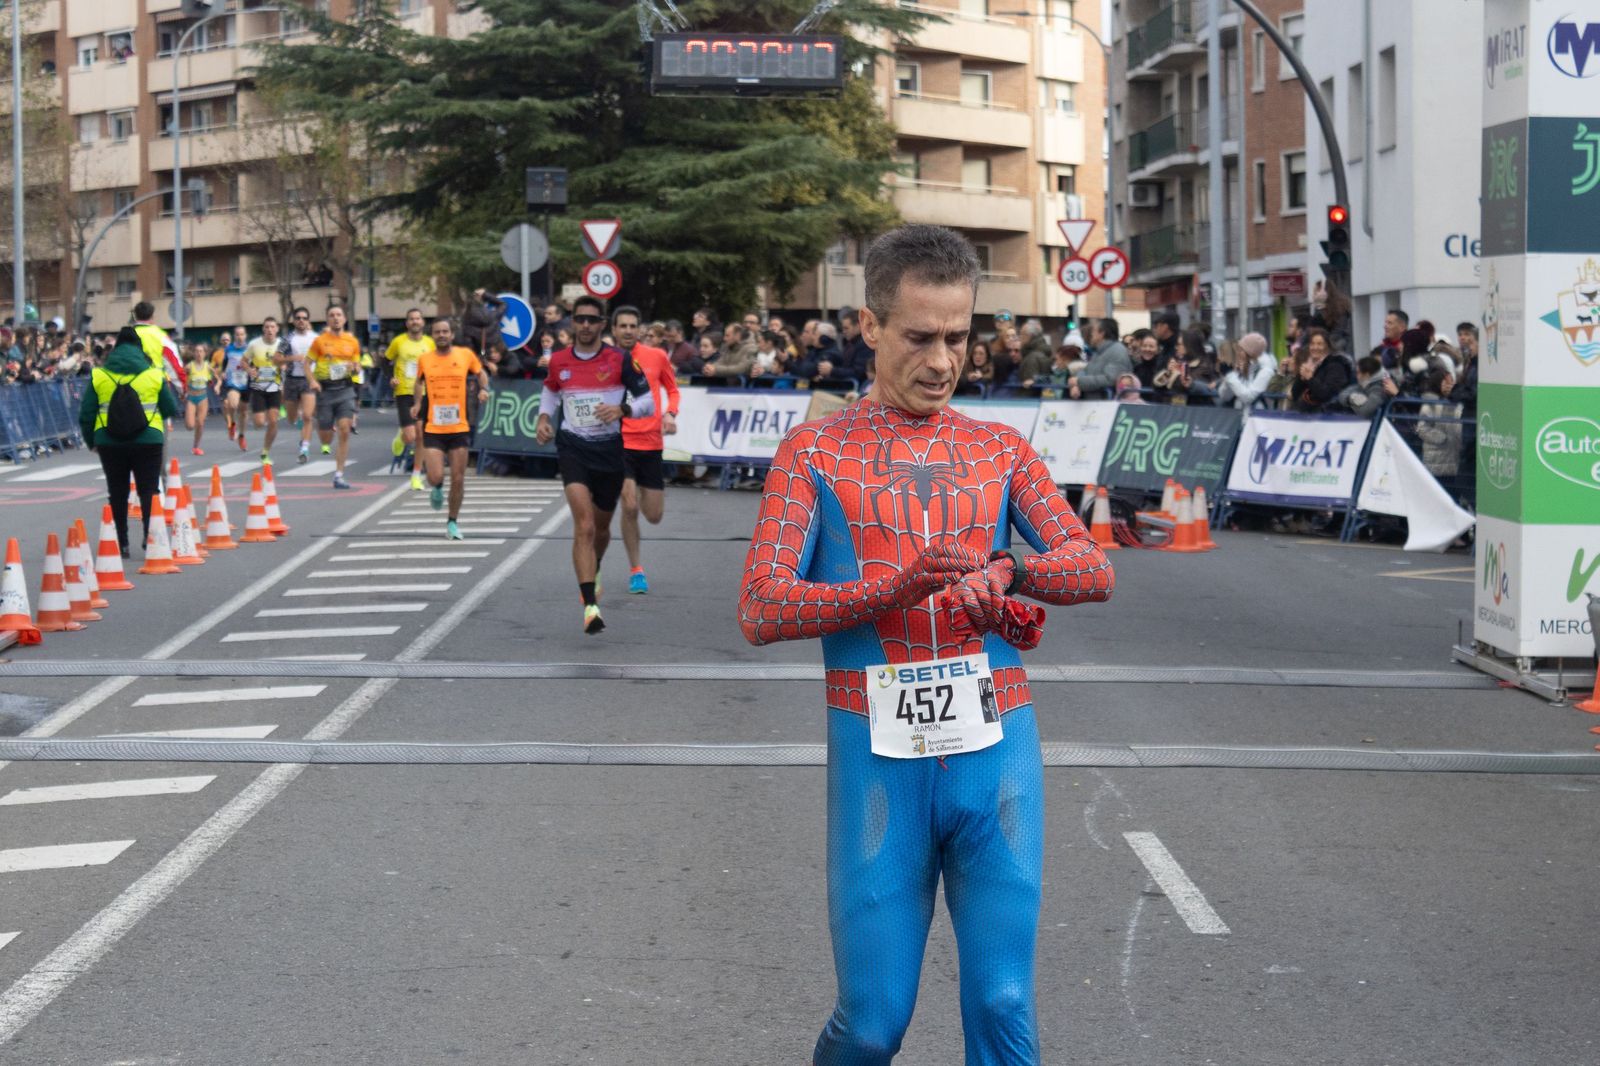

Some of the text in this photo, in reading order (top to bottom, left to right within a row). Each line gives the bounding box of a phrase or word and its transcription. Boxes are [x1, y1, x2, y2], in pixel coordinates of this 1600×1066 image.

[591, 273, 613, 287] 30
[1065, 270, 1088, 283] 30
[574, 404, 591, 417] 213
[898, 661, 978, 684] SETEL
[896, 684, 956, 725] 452
[914, 724, 941, 733] RAMÓN
[928, 737, 963, 746] Ayuntamiento
[935, 744, 963, 752] Salamanca
